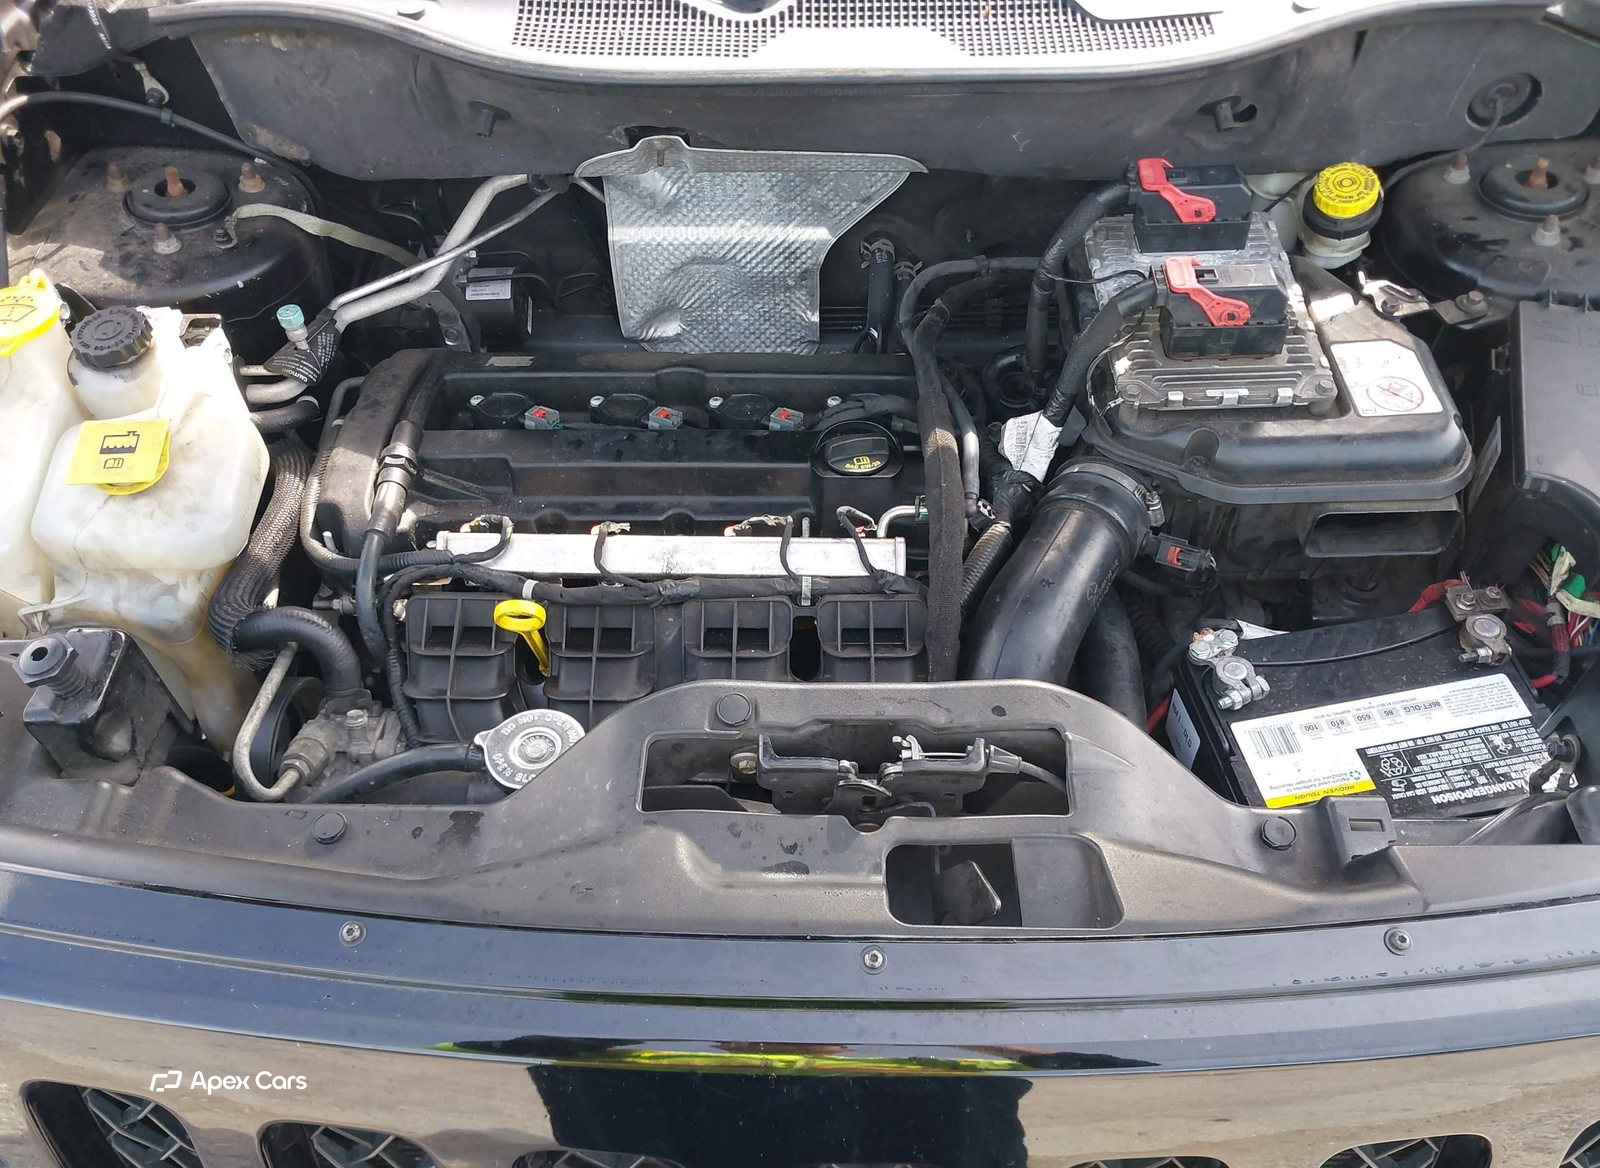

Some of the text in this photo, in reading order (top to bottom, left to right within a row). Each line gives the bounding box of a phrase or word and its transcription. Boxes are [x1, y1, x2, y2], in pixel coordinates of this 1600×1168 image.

[1402, 700, 1441, 712] 86FT-DLG
[1355, 713, 1371, 721] 650
[518, 713, 541, 725] NOT
[545, 714, 573, 731] OPEN
[1329, 718, 1345, 726] 810
[1303, 723, 1318, 731] 100
[1321, 772, 1348, 780] AutoZone
[1268, 781, 1294, 790] recycling
[1292, 783, 1317, 791] batteries
[1293, 785, 1355, 799] PROVEN TOUGH
[1430, 780, 1515, 804] DANGER/POISON
